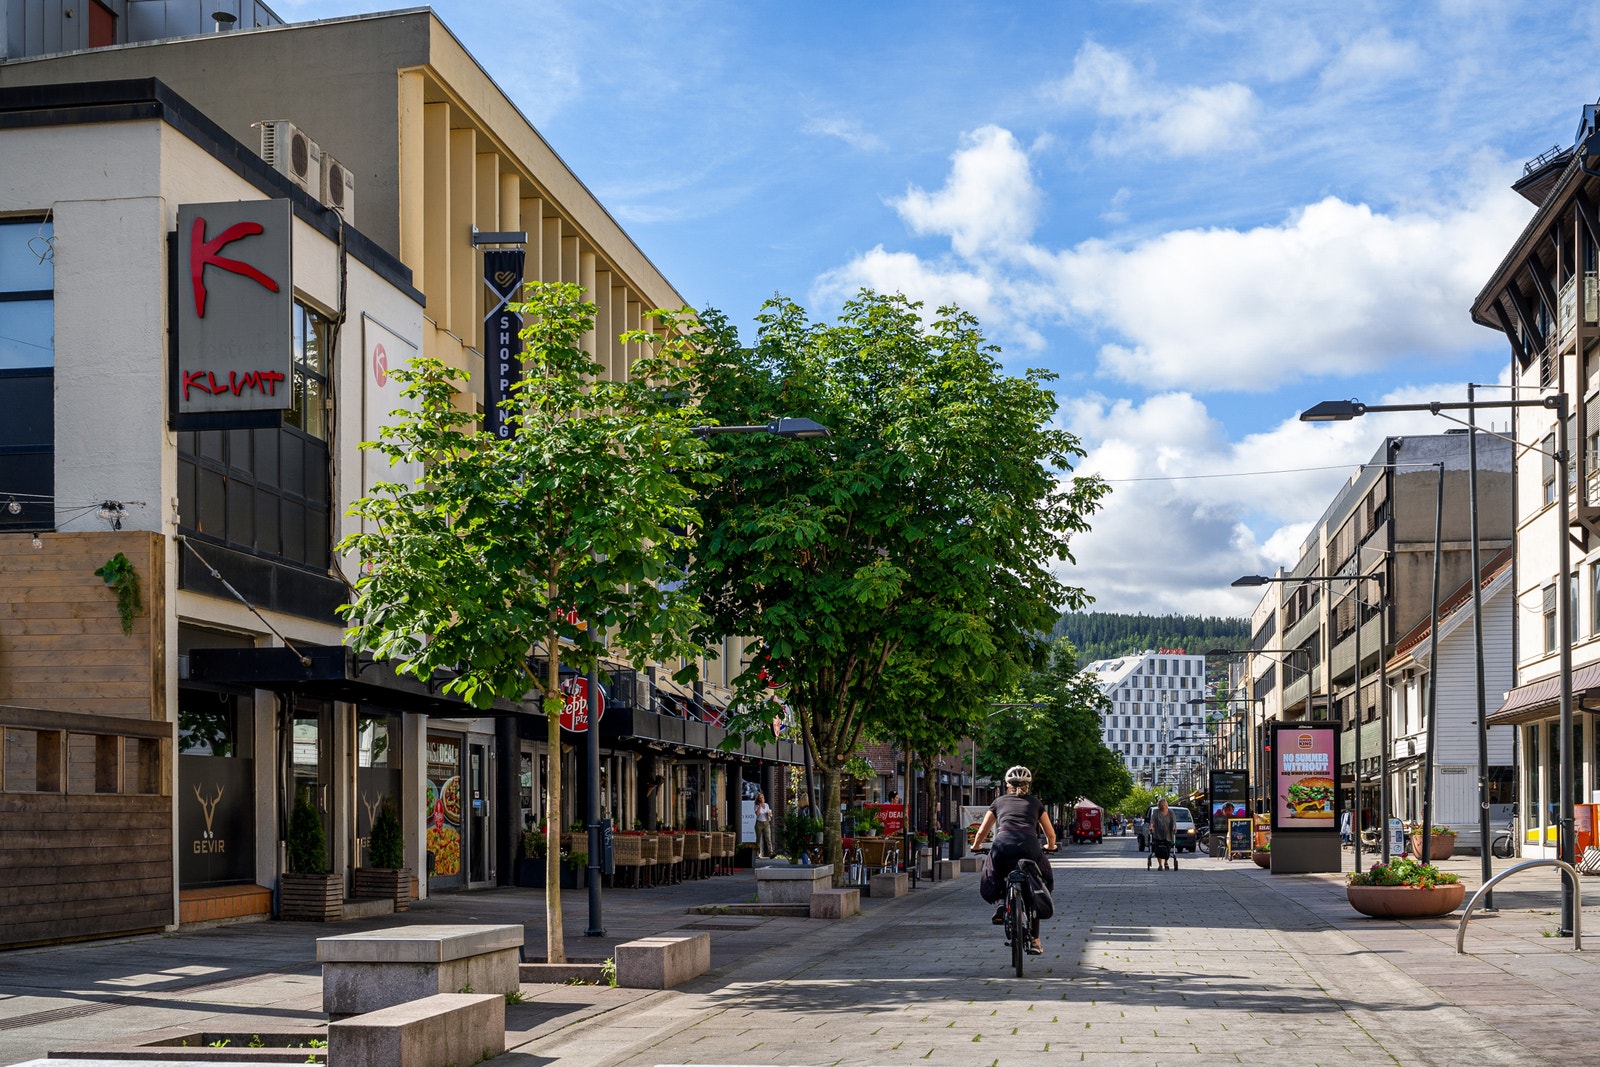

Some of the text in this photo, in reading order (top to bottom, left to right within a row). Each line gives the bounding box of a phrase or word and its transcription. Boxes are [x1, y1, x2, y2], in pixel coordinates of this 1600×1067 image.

[190, 216, 280, 319] K
[182, 369, 285, 402] KLIMT
[499, 316, 510, 439] SHOPPING
[559, 694, 589, 716] epp
[1283, 753, 1329, 763] NO SUMMER
[1283, 762, 1329, 772] WITHOUT
[193, 839, 225, 854] GEVIR
